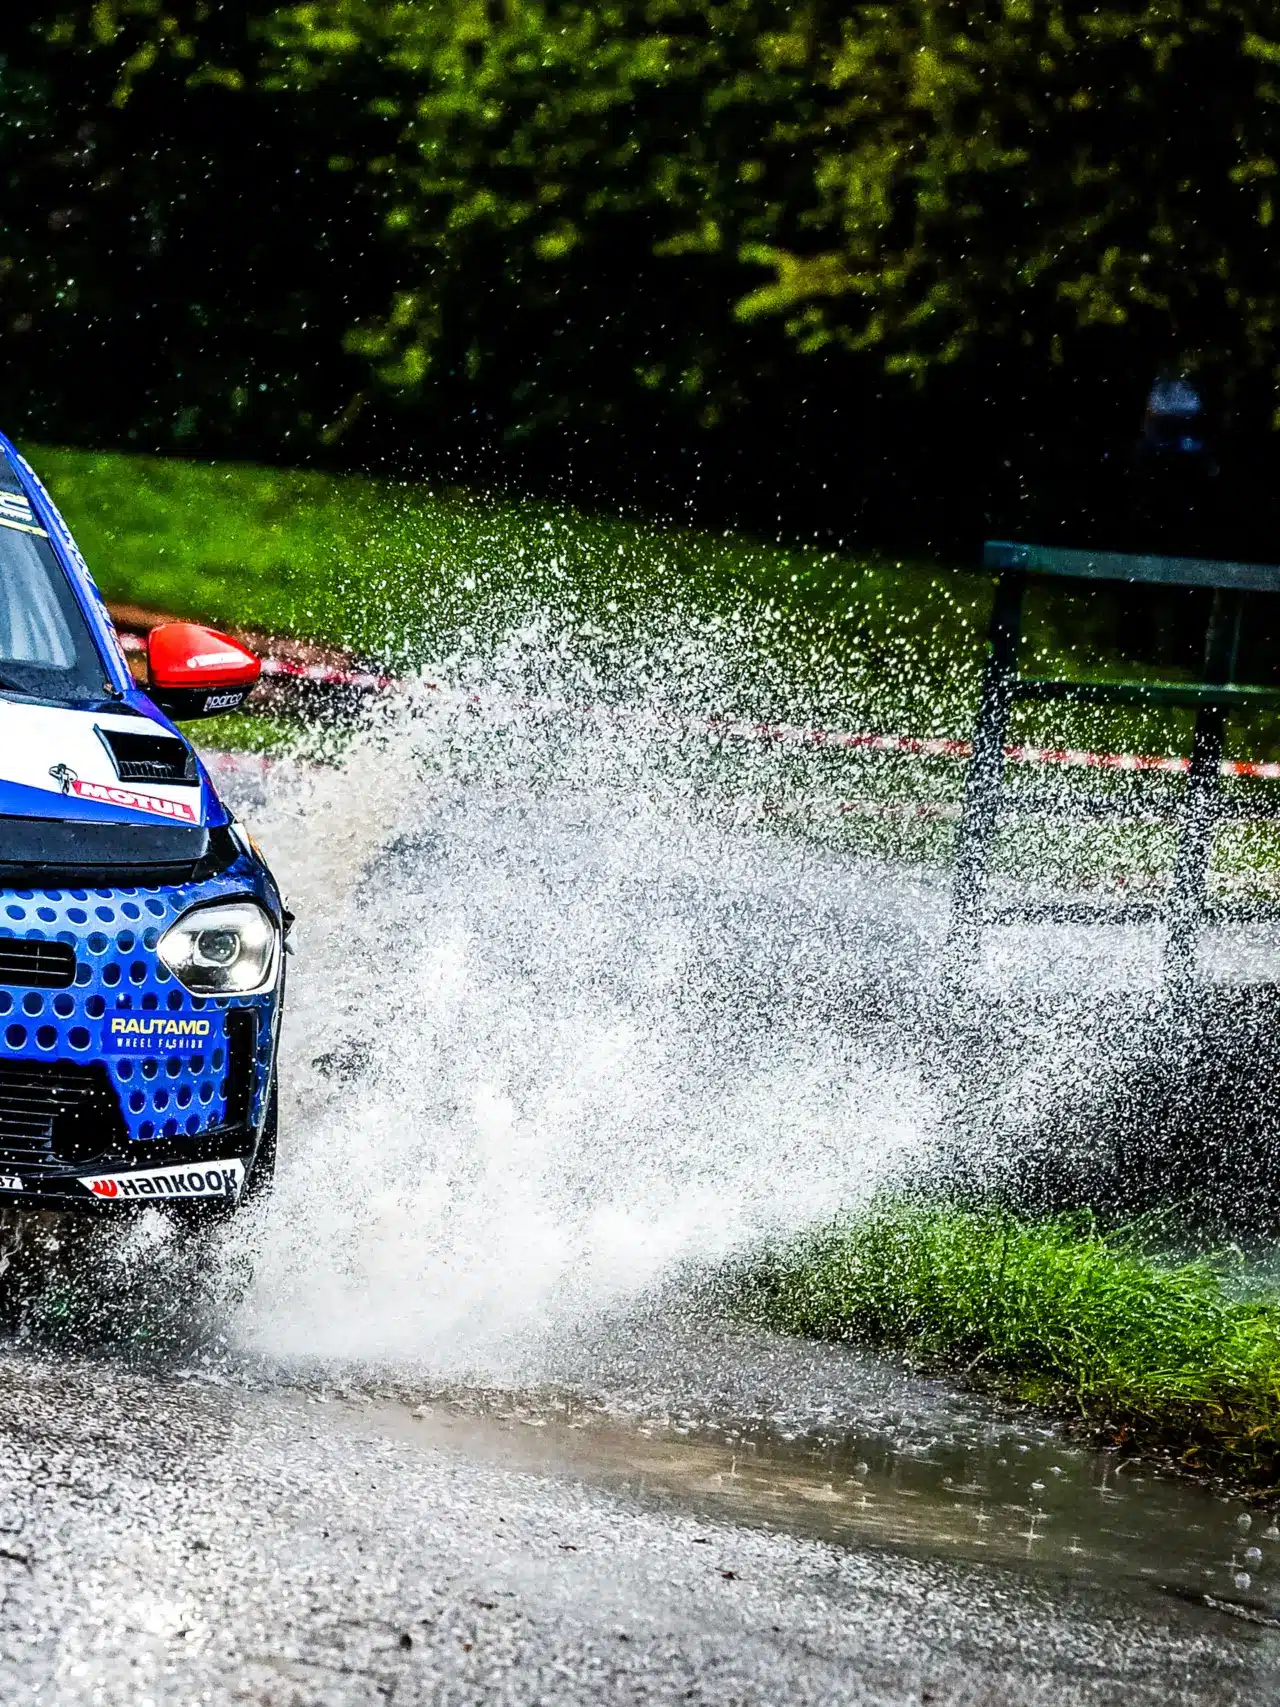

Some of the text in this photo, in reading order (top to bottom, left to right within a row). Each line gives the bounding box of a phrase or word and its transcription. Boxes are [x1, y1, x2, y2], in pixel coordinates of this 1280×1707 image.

[78, 783, 193, 819] MOTUL
[111, 1017, 210, 1036] RAUTAMO
[116, 1038, 204, 1050] WHEEL FASHION
[121, 1166, 237, 1197] Hankook
